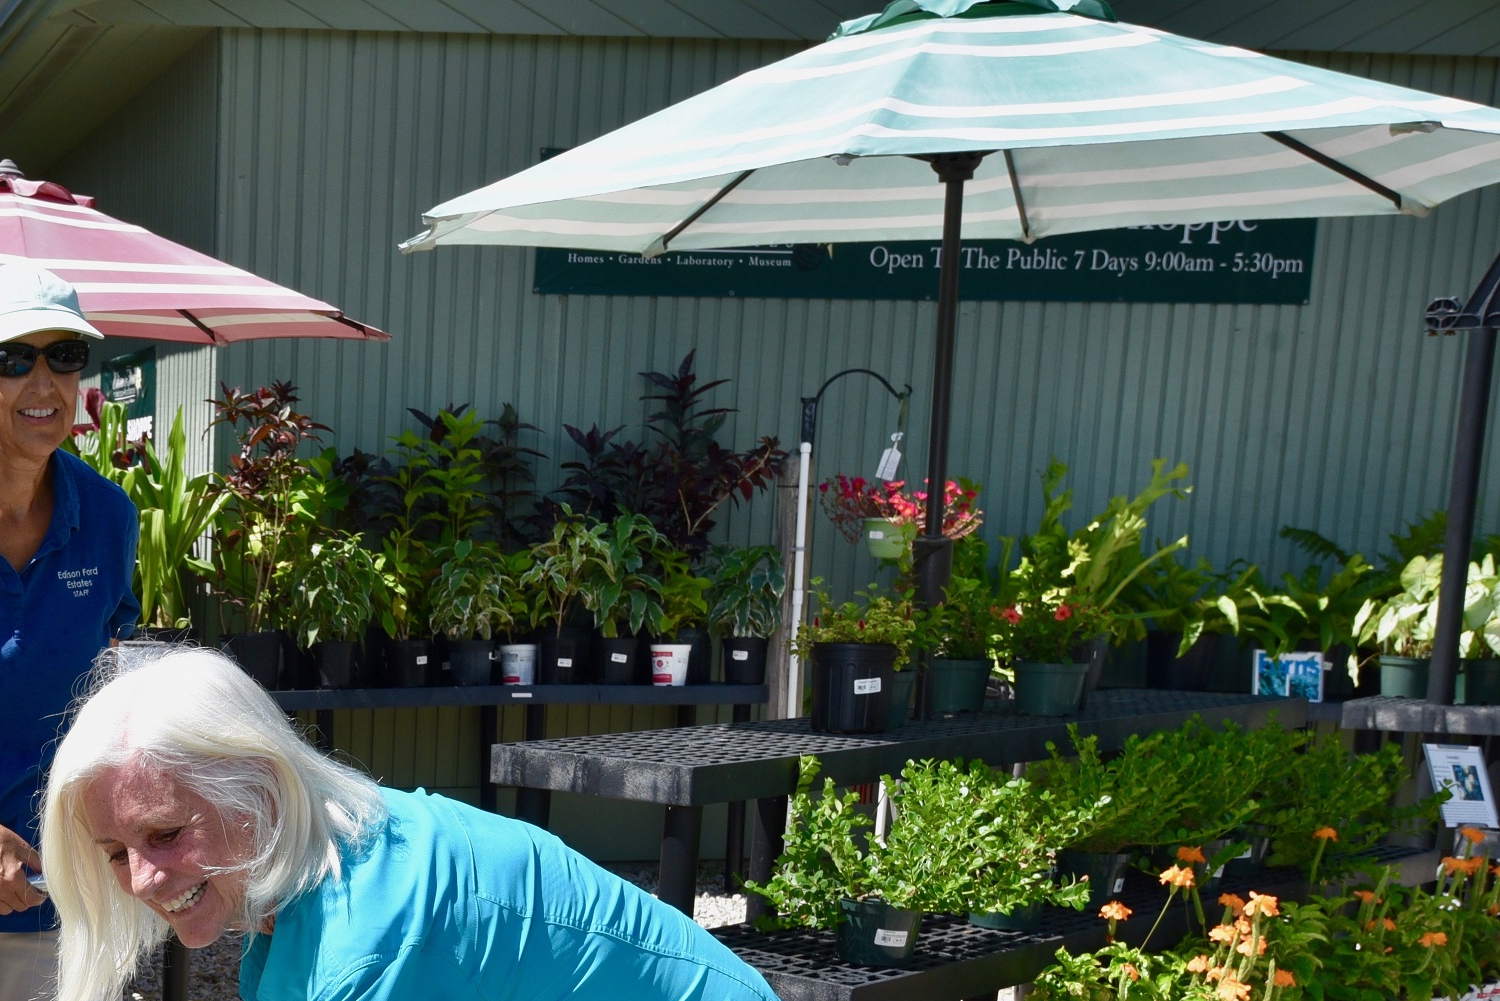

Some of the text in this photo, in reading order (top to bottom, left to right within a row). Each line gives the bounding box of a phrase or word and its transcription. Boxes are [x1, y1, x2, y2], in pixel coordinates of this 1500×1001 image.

[567, 252, 792, 269] Homes Gardens Laboratory Museum
[869, 245, 924, 275] Open
[930, 246, 943, 269] T
[961, 247, 1001, 270] The
[1005, 247, 1068, 271] Public
[1073, 250, 1086, 270] 7
[1090, 249, 1139, 278] Days
[1144, 251, 1215, 272] 9:00am
[1231, 252, 1304, 279] 5:30pm
[57, 566, 98, 580] Edison Ford
[66, 578, 93, 589] Estates
[72, 588, 90, 598] STAFF
